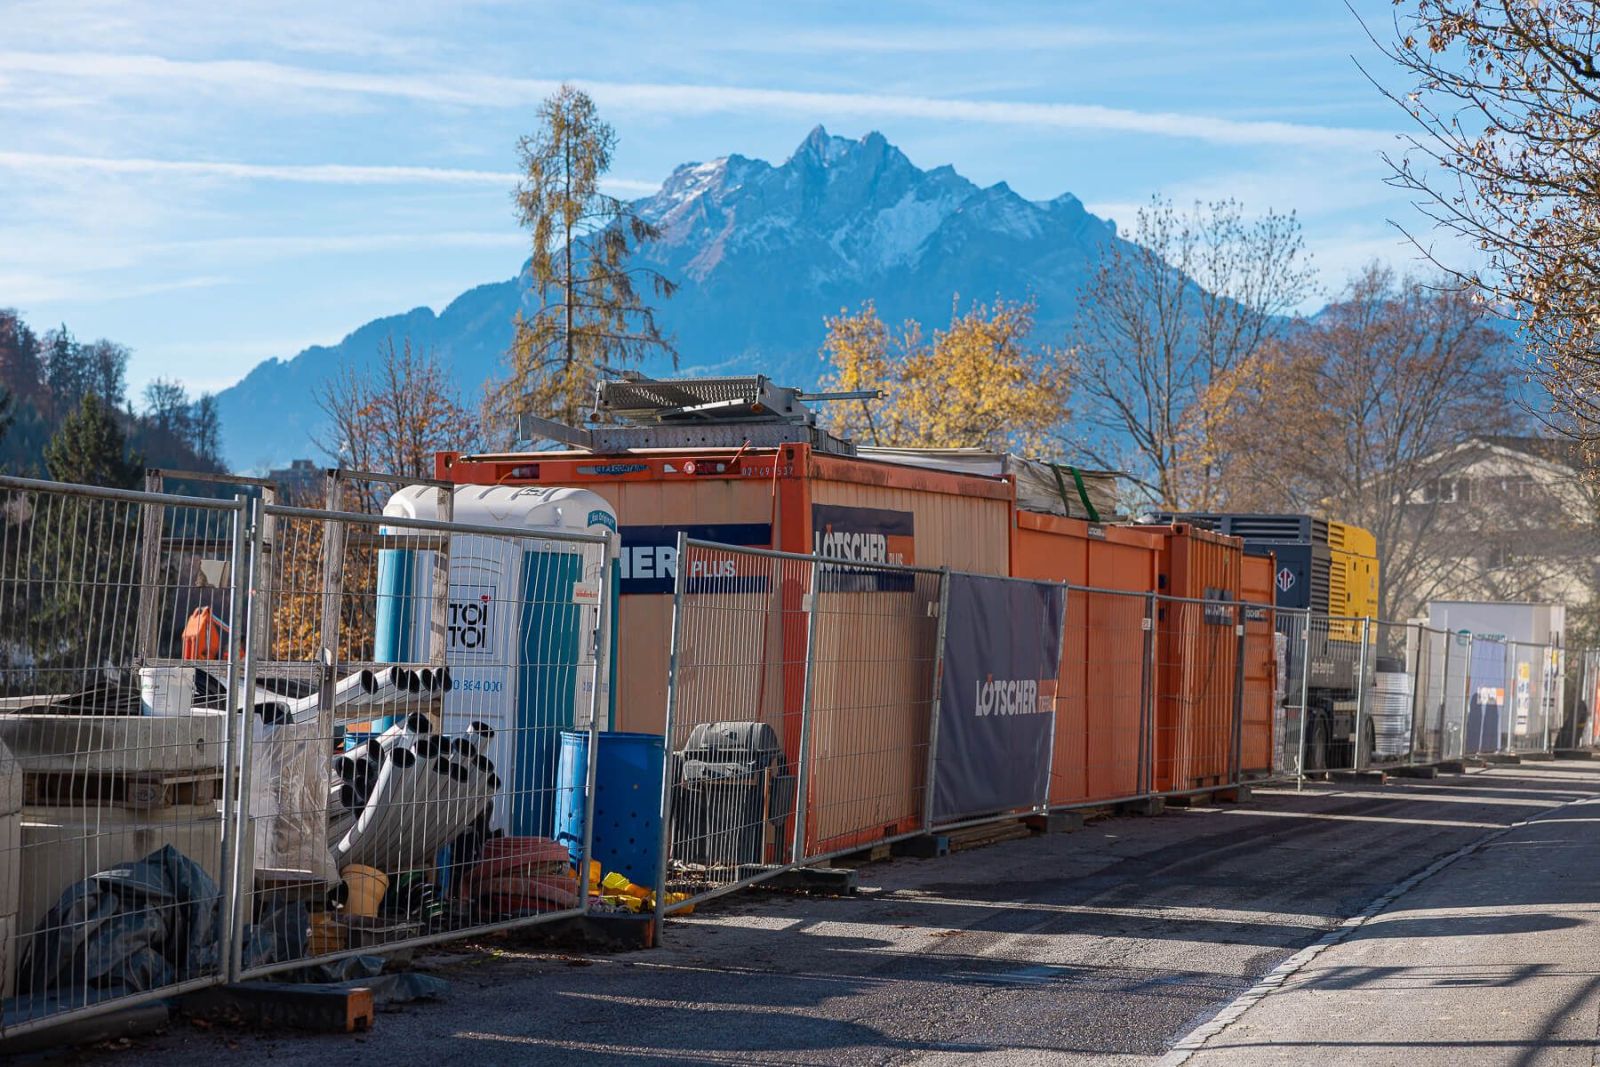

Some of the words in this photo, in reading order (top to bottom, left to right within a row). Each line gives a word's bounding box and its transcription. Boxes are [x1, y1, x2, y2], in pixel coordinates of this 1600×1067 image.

[692, 559, 736, 578] PLUS
[449, 603, 488, 625] TOI
[448, 626, 486, 649] TOI
